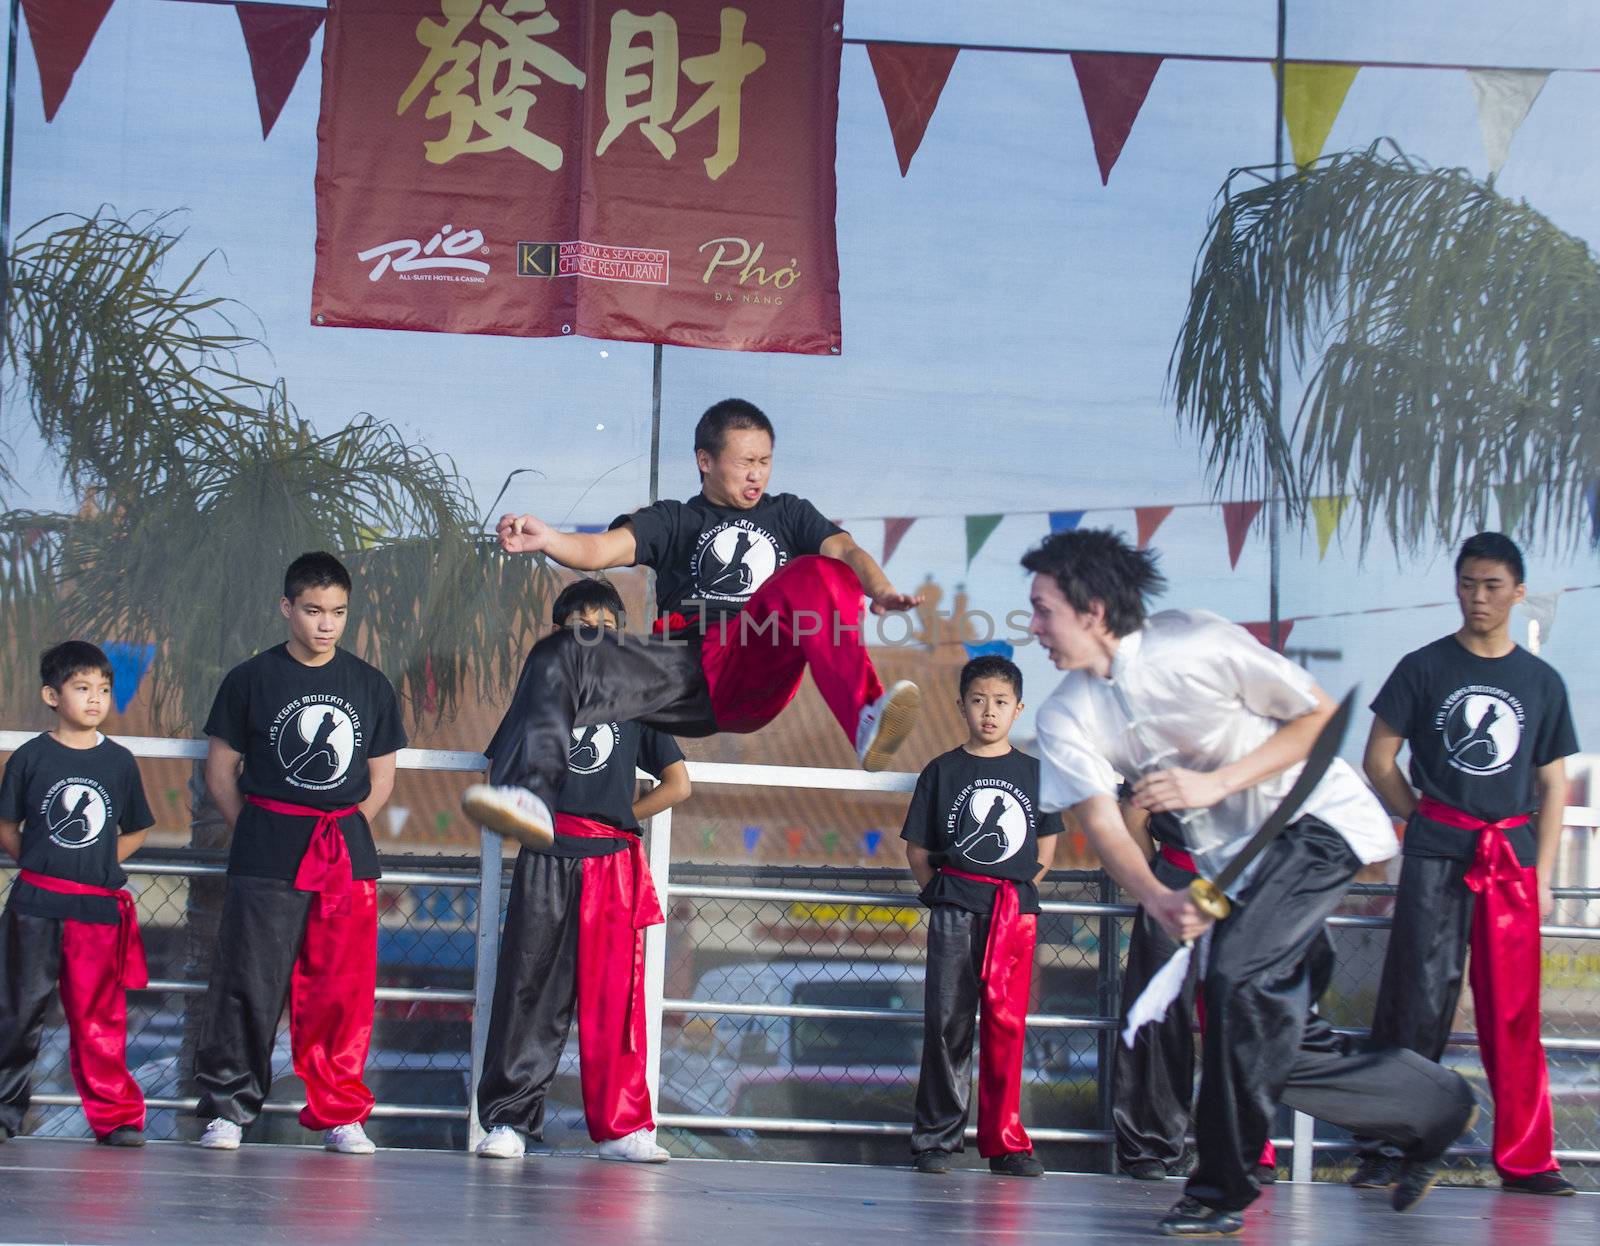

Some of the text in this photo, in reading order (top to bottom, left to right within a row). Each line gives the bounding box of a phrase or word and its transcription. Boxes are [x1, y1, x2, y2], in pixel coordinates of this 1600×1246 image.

[357, 224, 490, 281] Rio
[522, 245, 557, 281] KJ
[560, 245, 665, 263] DIM SUM & SEAFOOD
[433, 274, 455, 282] HOTEL
[460, 275, 486, 283] CASINO
[559, 258, 663, 281] CHINESE RESTAURANT
[274, 699, 301, 724] VEGAS
[302, 694, 344, 706] MODERN
[344, 702, 361, 729] KUNG
[354, 732, 363, 747] FU
[974, 778, 1014, 791] MODERN
[951, 784, 974, 811] VEGAS
[1012, 787, 1032, 812] KUNG
[947, 813, 957, 834] LAS
